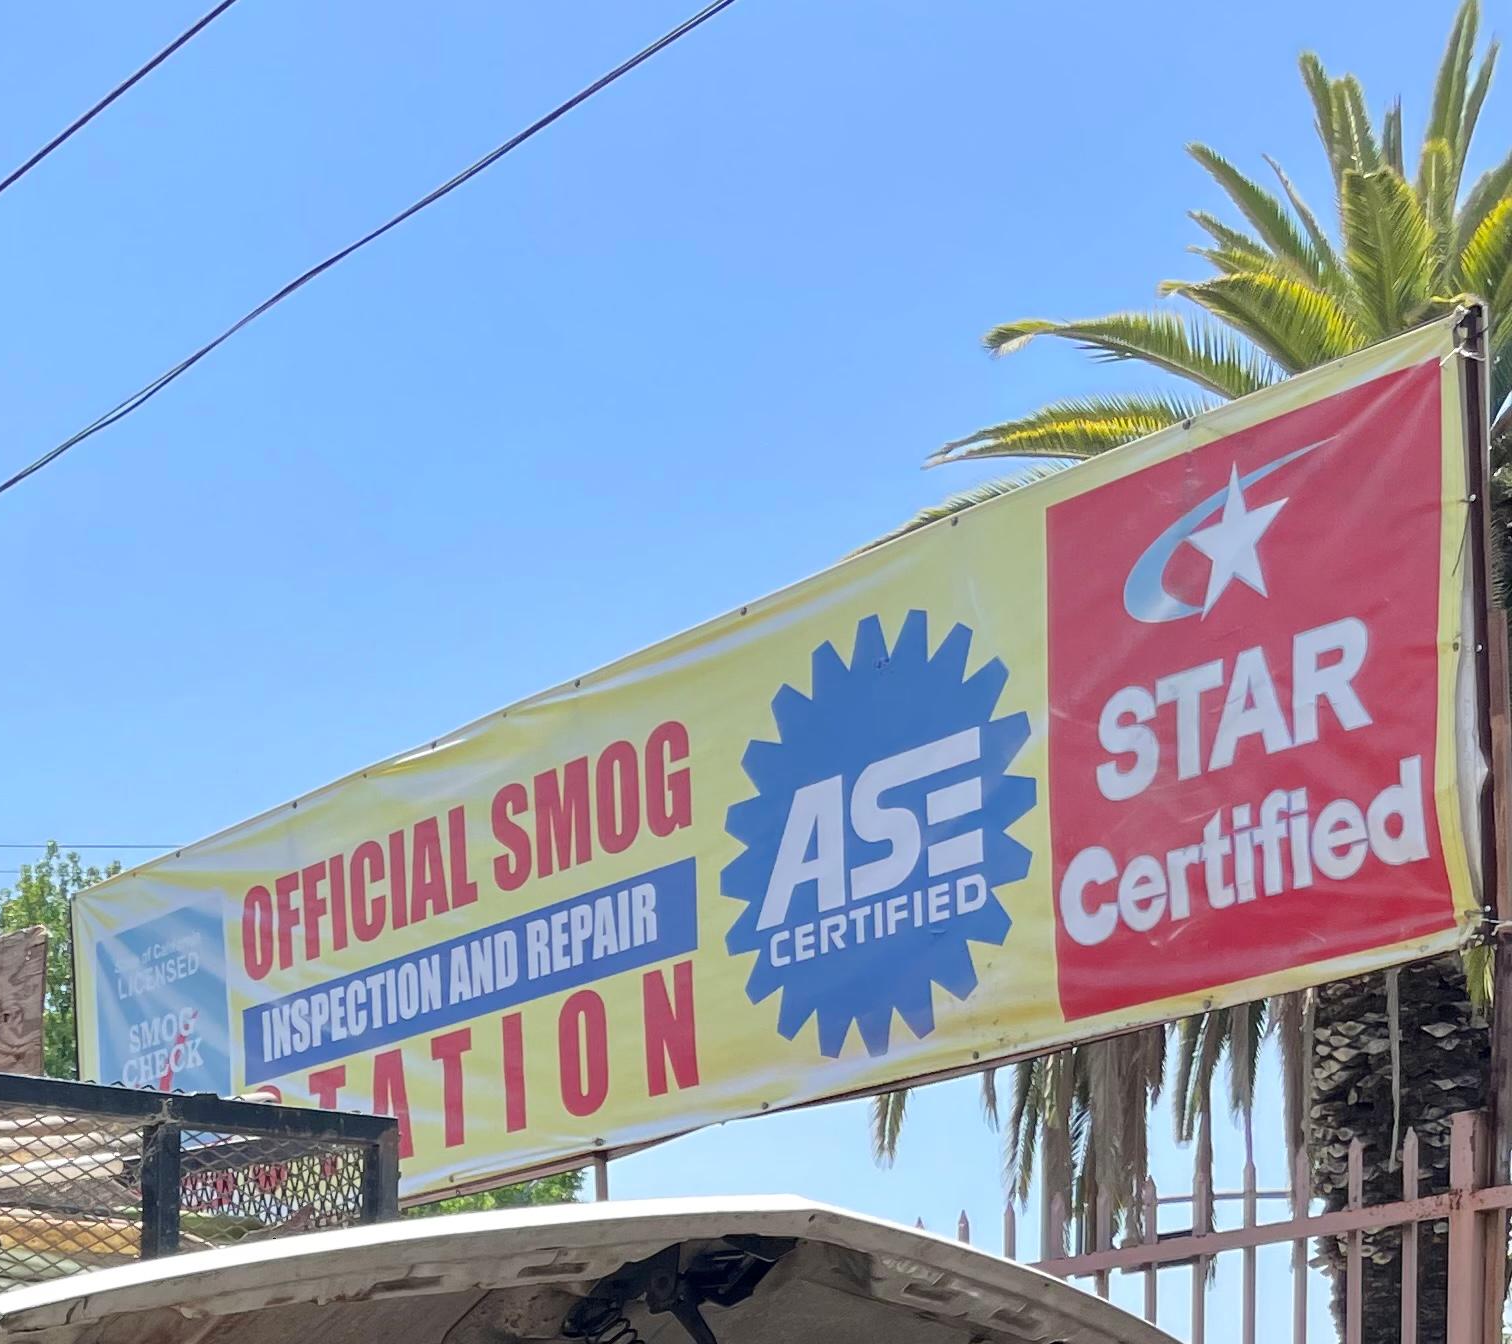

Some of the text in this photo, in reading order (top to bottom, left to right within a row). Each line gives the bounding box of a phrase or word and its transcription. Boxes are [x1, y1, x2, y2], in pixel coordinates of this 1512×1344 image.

[1096, 617, 1373, 802] STAR
[241, 721, 693, 982] OFFICIAL SMOG
[755, 726, 985, 931] ASE
[1059, 755, 1431, 947] Certified
[117, 951, 200, 1001] LICENSED
[262, 882, 658, 1064] INSPECTION AND REPAIR
[768, 873, 988, 969] CERTIFIED
[122, 1036, 205, 1088] CHECK
[129, 1007, 196, 1052] SMOG
[258, 959, 701, 1160] ATION
